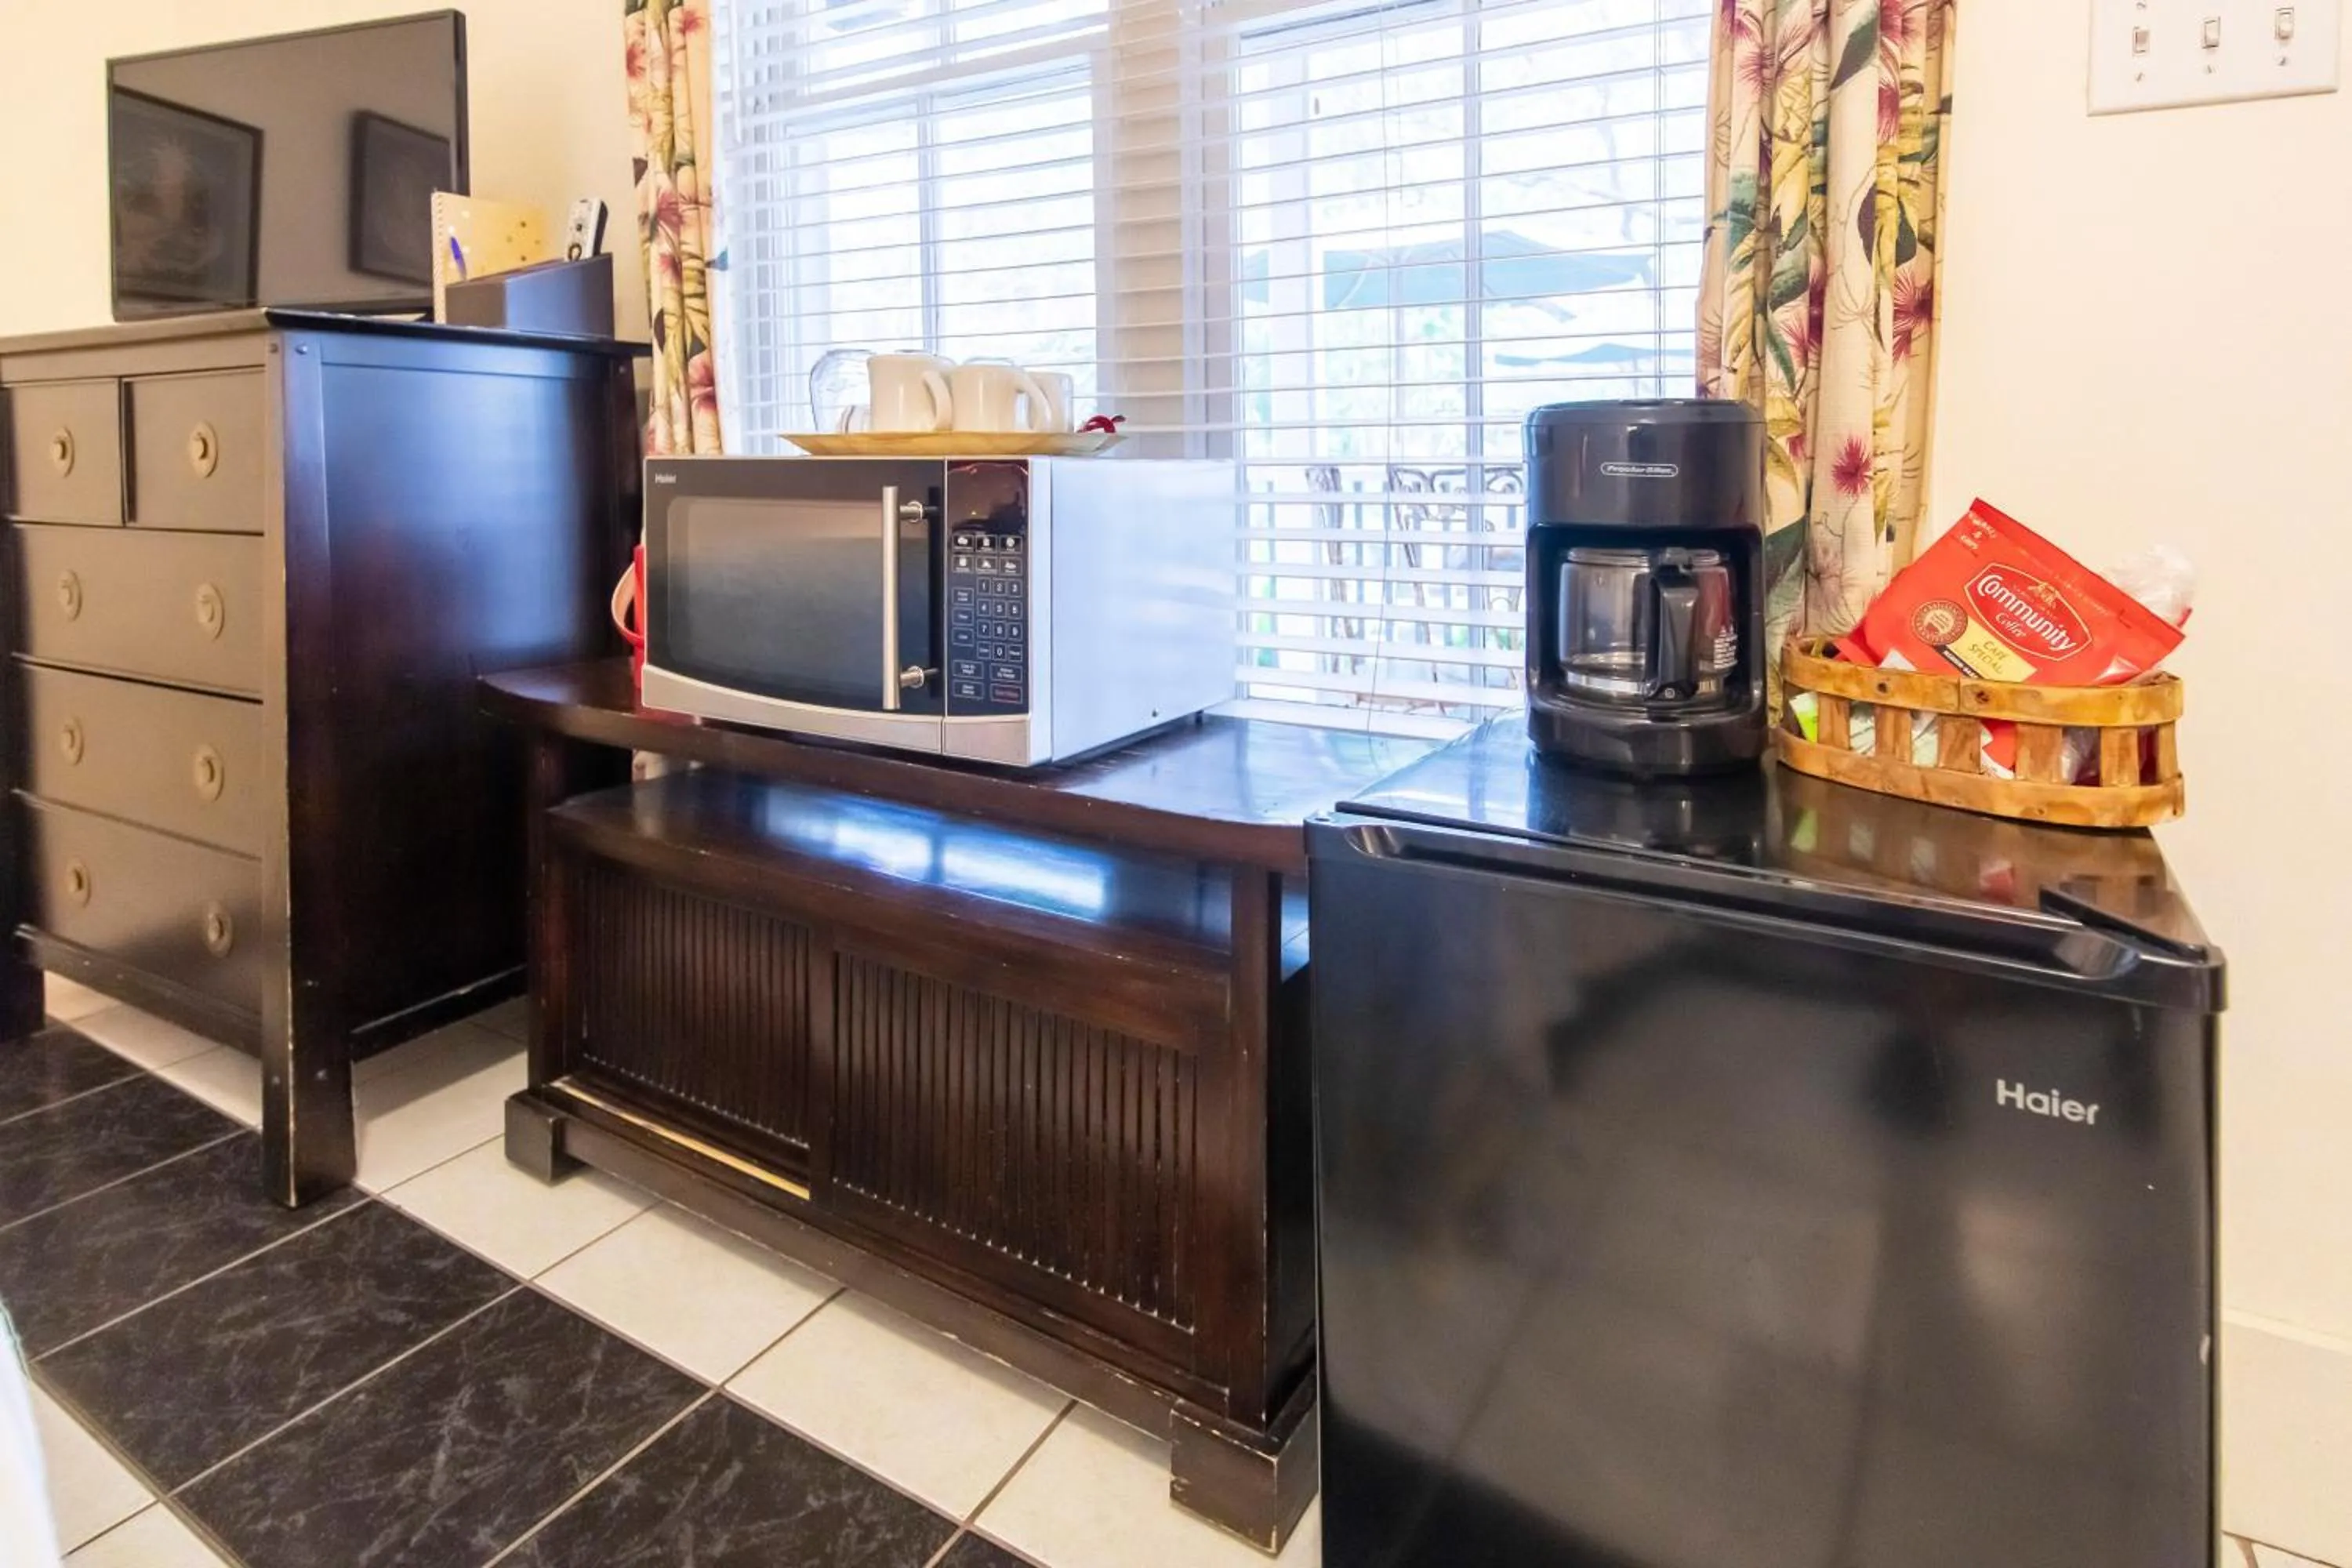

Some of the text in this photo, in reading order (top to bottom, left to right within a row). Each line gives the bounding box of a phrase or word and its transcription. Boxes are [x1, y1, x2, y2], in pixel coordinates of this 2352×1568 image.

[1977, 574, 2077, 652] Community
[1995, 612, 2027, 637] Coffee
[1996, 1078, 2100, 1125] Haier
